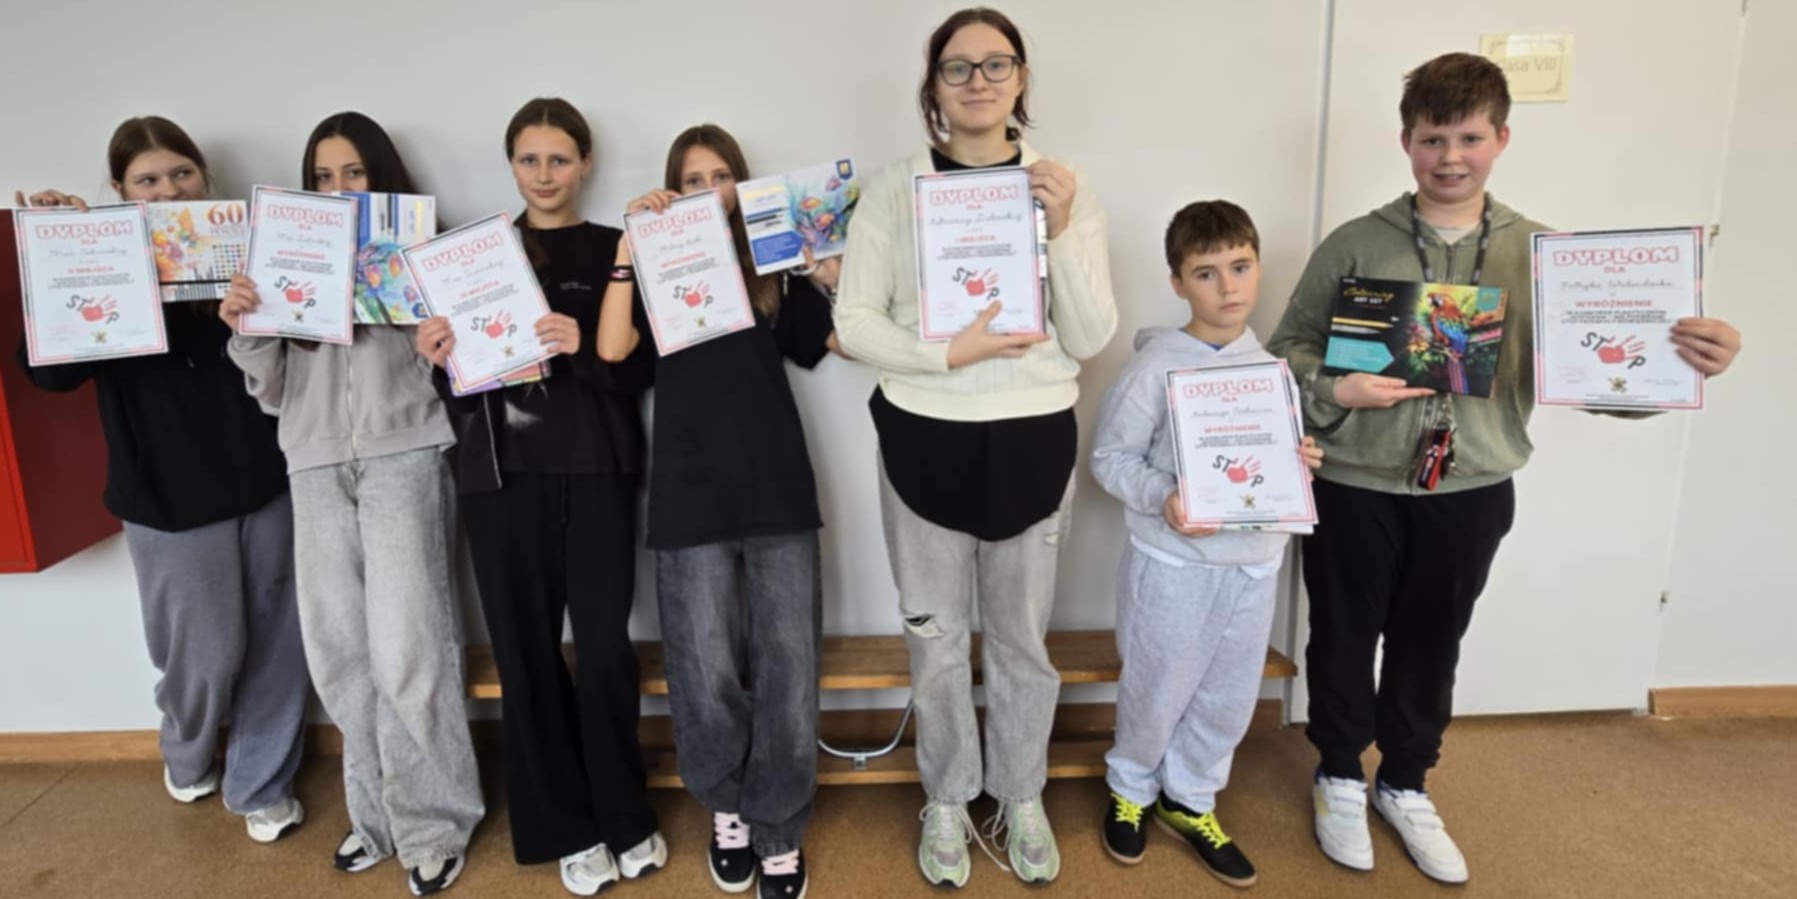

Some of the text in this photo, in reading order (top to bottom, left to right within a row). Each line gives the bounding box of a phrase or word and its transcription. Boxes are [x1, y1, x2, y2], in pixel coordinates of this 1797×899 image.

[930, 185, 1019, 206] DYPLOM
[207, 203, 244, 225] 60
[267, 204, 345, 228] DYPLOM
[638, 205, 712, 239] DYPLOM
[35, 220, 133, 239] DYPLOM
[422, 231, 503, 272] DYPLOM
[1553, 246, 1679, 266] DYPLOM
[1603, 266, 1627, 274] DLA
[1183, 379, 1273, 398] DYPLOM
